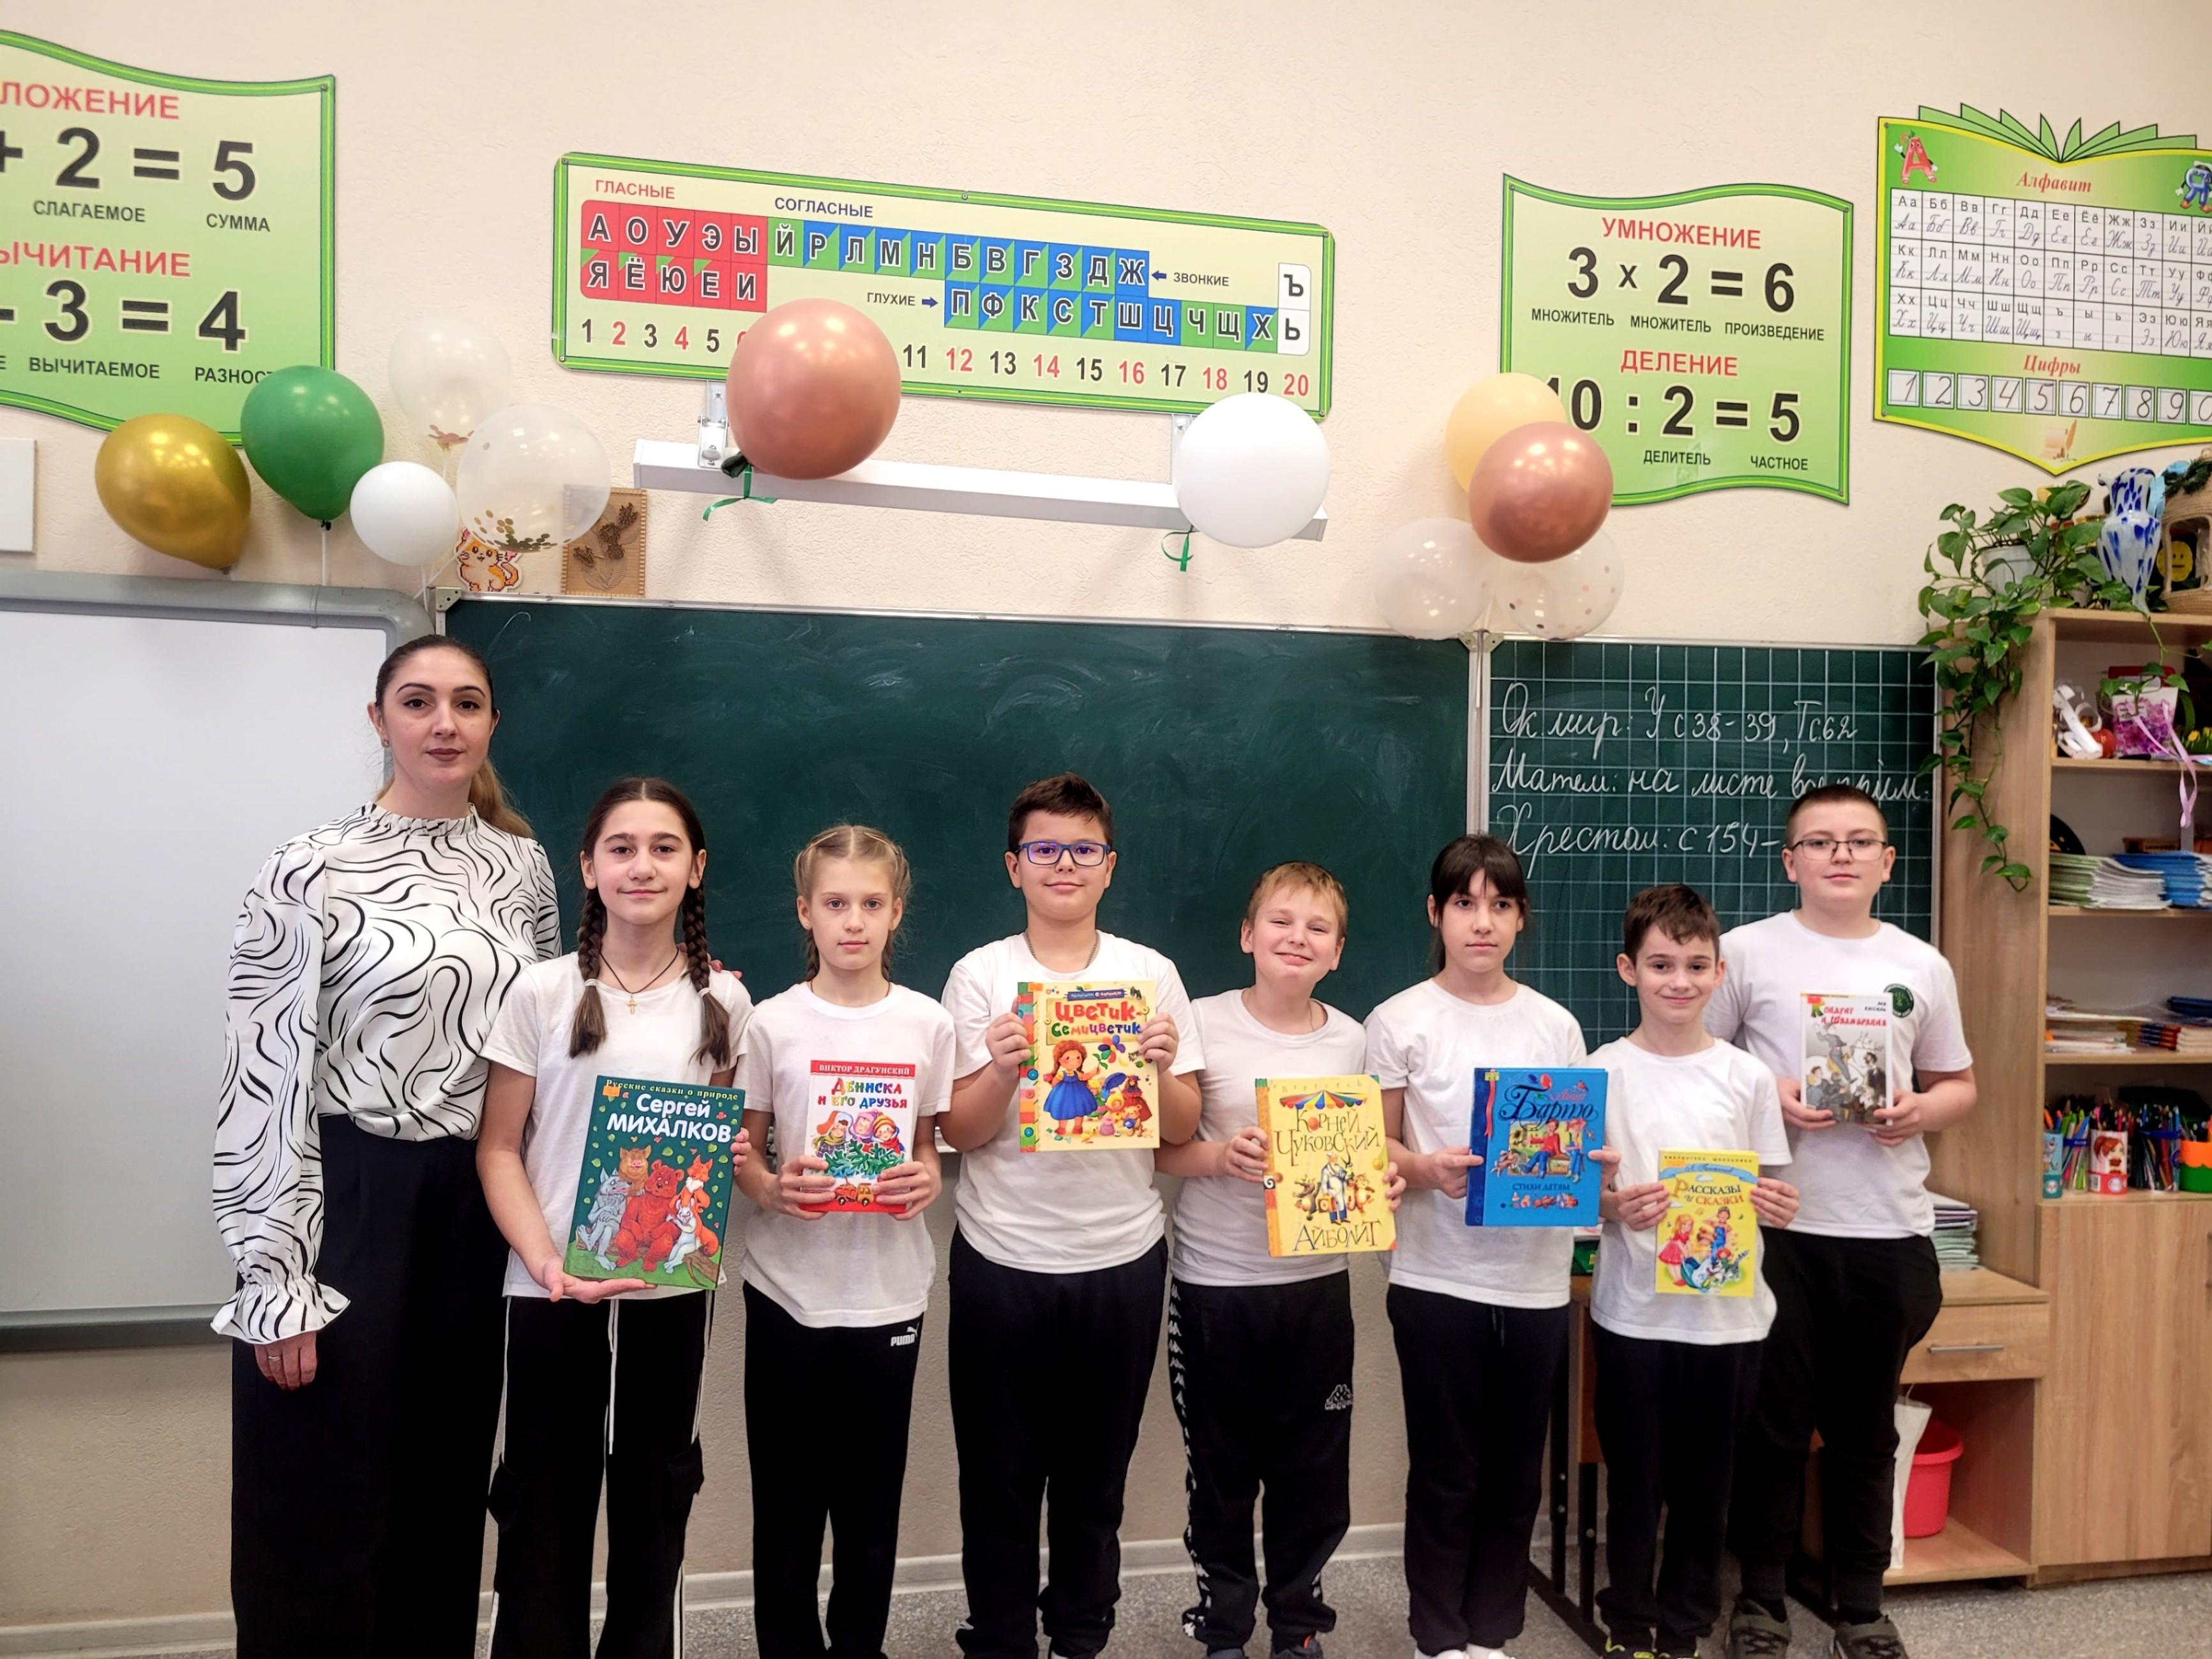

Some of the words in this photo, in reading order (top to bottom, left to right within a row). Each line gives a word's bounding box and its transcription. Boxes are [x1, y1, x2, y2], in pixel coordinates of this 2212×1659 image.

[57, 128, 99, 188] 2
[213, 141, 255, 200] 5
[596, 179, 675, 199] ГЛАСНЫЕ
[2016, 170, 2093, 194] Алфавит
[34, 201, 144, 221] СЛАГАЕМОЕ
[207, 214, 269, 231] СУММА
[774, 197, 874, 219] СОГЛАСНЫЕ
[1603, 218, 1760, 250] УМНОЖЕНИЕ
[590, 214, 609, 241] А
[628, 218, 647, 244] О
[665, 221, 688, 246] У
[703, 225, 721, 250] Э
[735, 227, 757, 253] Ы
[776, 224, 794, 255] Й
[811, 234, 826, 258] Р
[846, 237, 864, 262] Л
[881, 240, 900, 266] М
[919, 244, 935, 269] Н
[954, 244, 972, 269] Б
[988, 248, 1005, 272] В
[1025, 251, 1039, 274] Г
[1057, 254, 1072, 279] З
[1088, 257, 1108, 286] Д
[1120, 259, 1144, 284] Ж
[1174, 273, 1228, 286] ЗВОНКИЕ
[1283, 273, 1304, 297] Ъ
[1569, 248, 1598, 297] 3
[1658, 255, 1688, 304] 2
[1765, 263, 1794, 312] 6
[45, 280, 88, 341] 3
[199, 292, 245, 350] 4
[589, 262, 607, 287] Я
[627, 258, 644, 289] Ё
[662, 266, 685, 292] Ю
[702, 271, 718, 297] Е
[738, 274, 755, 299] И
[868, 293, 915, 306] ГЛУХИЕ
[952, 290, 970, 315] П
[982, 293, 1004, 317] Ф
[1022, 296, 1038, 320] К
[1055, 299, 1072, 323] С
[1091, 301, 1108, 326] Т
[1119, 303, 1141, 329] Ш
[1155, 306, 1173, 336] Ц
[1189, 309, 1205, 333] Ч
[1217, 312, 1240, 342] Щ
[1254, 315, 1270, 339] Х
[1284, 317, 1301, 341] Ь
[1532, 309, 1614, 325] МНОЖИТЕЛЬ
[1631, 316, 1711, 332] МНОЖИТЕЛЬ
[1726, 323, 1823, 340] ПРОИЗВЕДЕНИЕ
[30, 357, 159, 378] ВЫЧИТАЕМОЕ
[195, 366, 273, 384] РАЗНОС
[582, 318, 592, 343] 1
[612, 320, 626, 347] 2
[643, 323, 658, 349] 3
[674, 326, 689, 349] 4
[706, 328, 720, 353] 5
[903, 343, 926, 369] 11
[946, 347, 973, 372] 12
[989, 350, 1017, 375] 13
[1035, 354, 1060, 377] 14
[1076, 357, 1103, 382] 15
[1119, 361, 1145, 385] 16
[1161, 363, 1187, 387] 17
[1203, 367, 1228, 391] 18
[1244, 370, 1268, 394] 19
[1283, 372, 1309, 397] 20
[1621, 350, 1736, 376] ДЕЛЕНИЕ
[2024, 356, 2079, 375] Цифры
[1906, 373, 1917, 402] 1
[1936, 376, 1952, 405] 2
[1968, 379, 1986, 407] 3
[1999, 380, 2020, 409] 4
[2034, 383, 2054, 410] 5
[2070, 386, 2086, 413] 6
[2103, 387, 2120, 416] 7
[2137, 390, 2151, 417] 8
[2167, 392, 2184, 419] 9
[1663, 386, 1693, 435] 2
[1770, 393, 1799, 441] 5
[1644, 451, 1710, 464] ДЕЛИТЕЛЬ
[1751, 456, 1807, 470] ЧАСТНОЕ
[1629, 768, 1680, 792] на
[1691, 773, 1778, 799] листе
[819, 1064, 852, 1072] ВИКТОР
[854, 1066, 910, 1074] ДРАГУНСКИЙ
[636, 1093, 711, 1118] Сергей
[650, 1086, 683, 1095] сказки
[697, 1091, 738, 1100] природе
[1498, 1085, 1599, 1125] Барто
[606, 1113, 732, 1143] МИХАЛКОВ
[890, 1333, 915, 1347] PUMA
